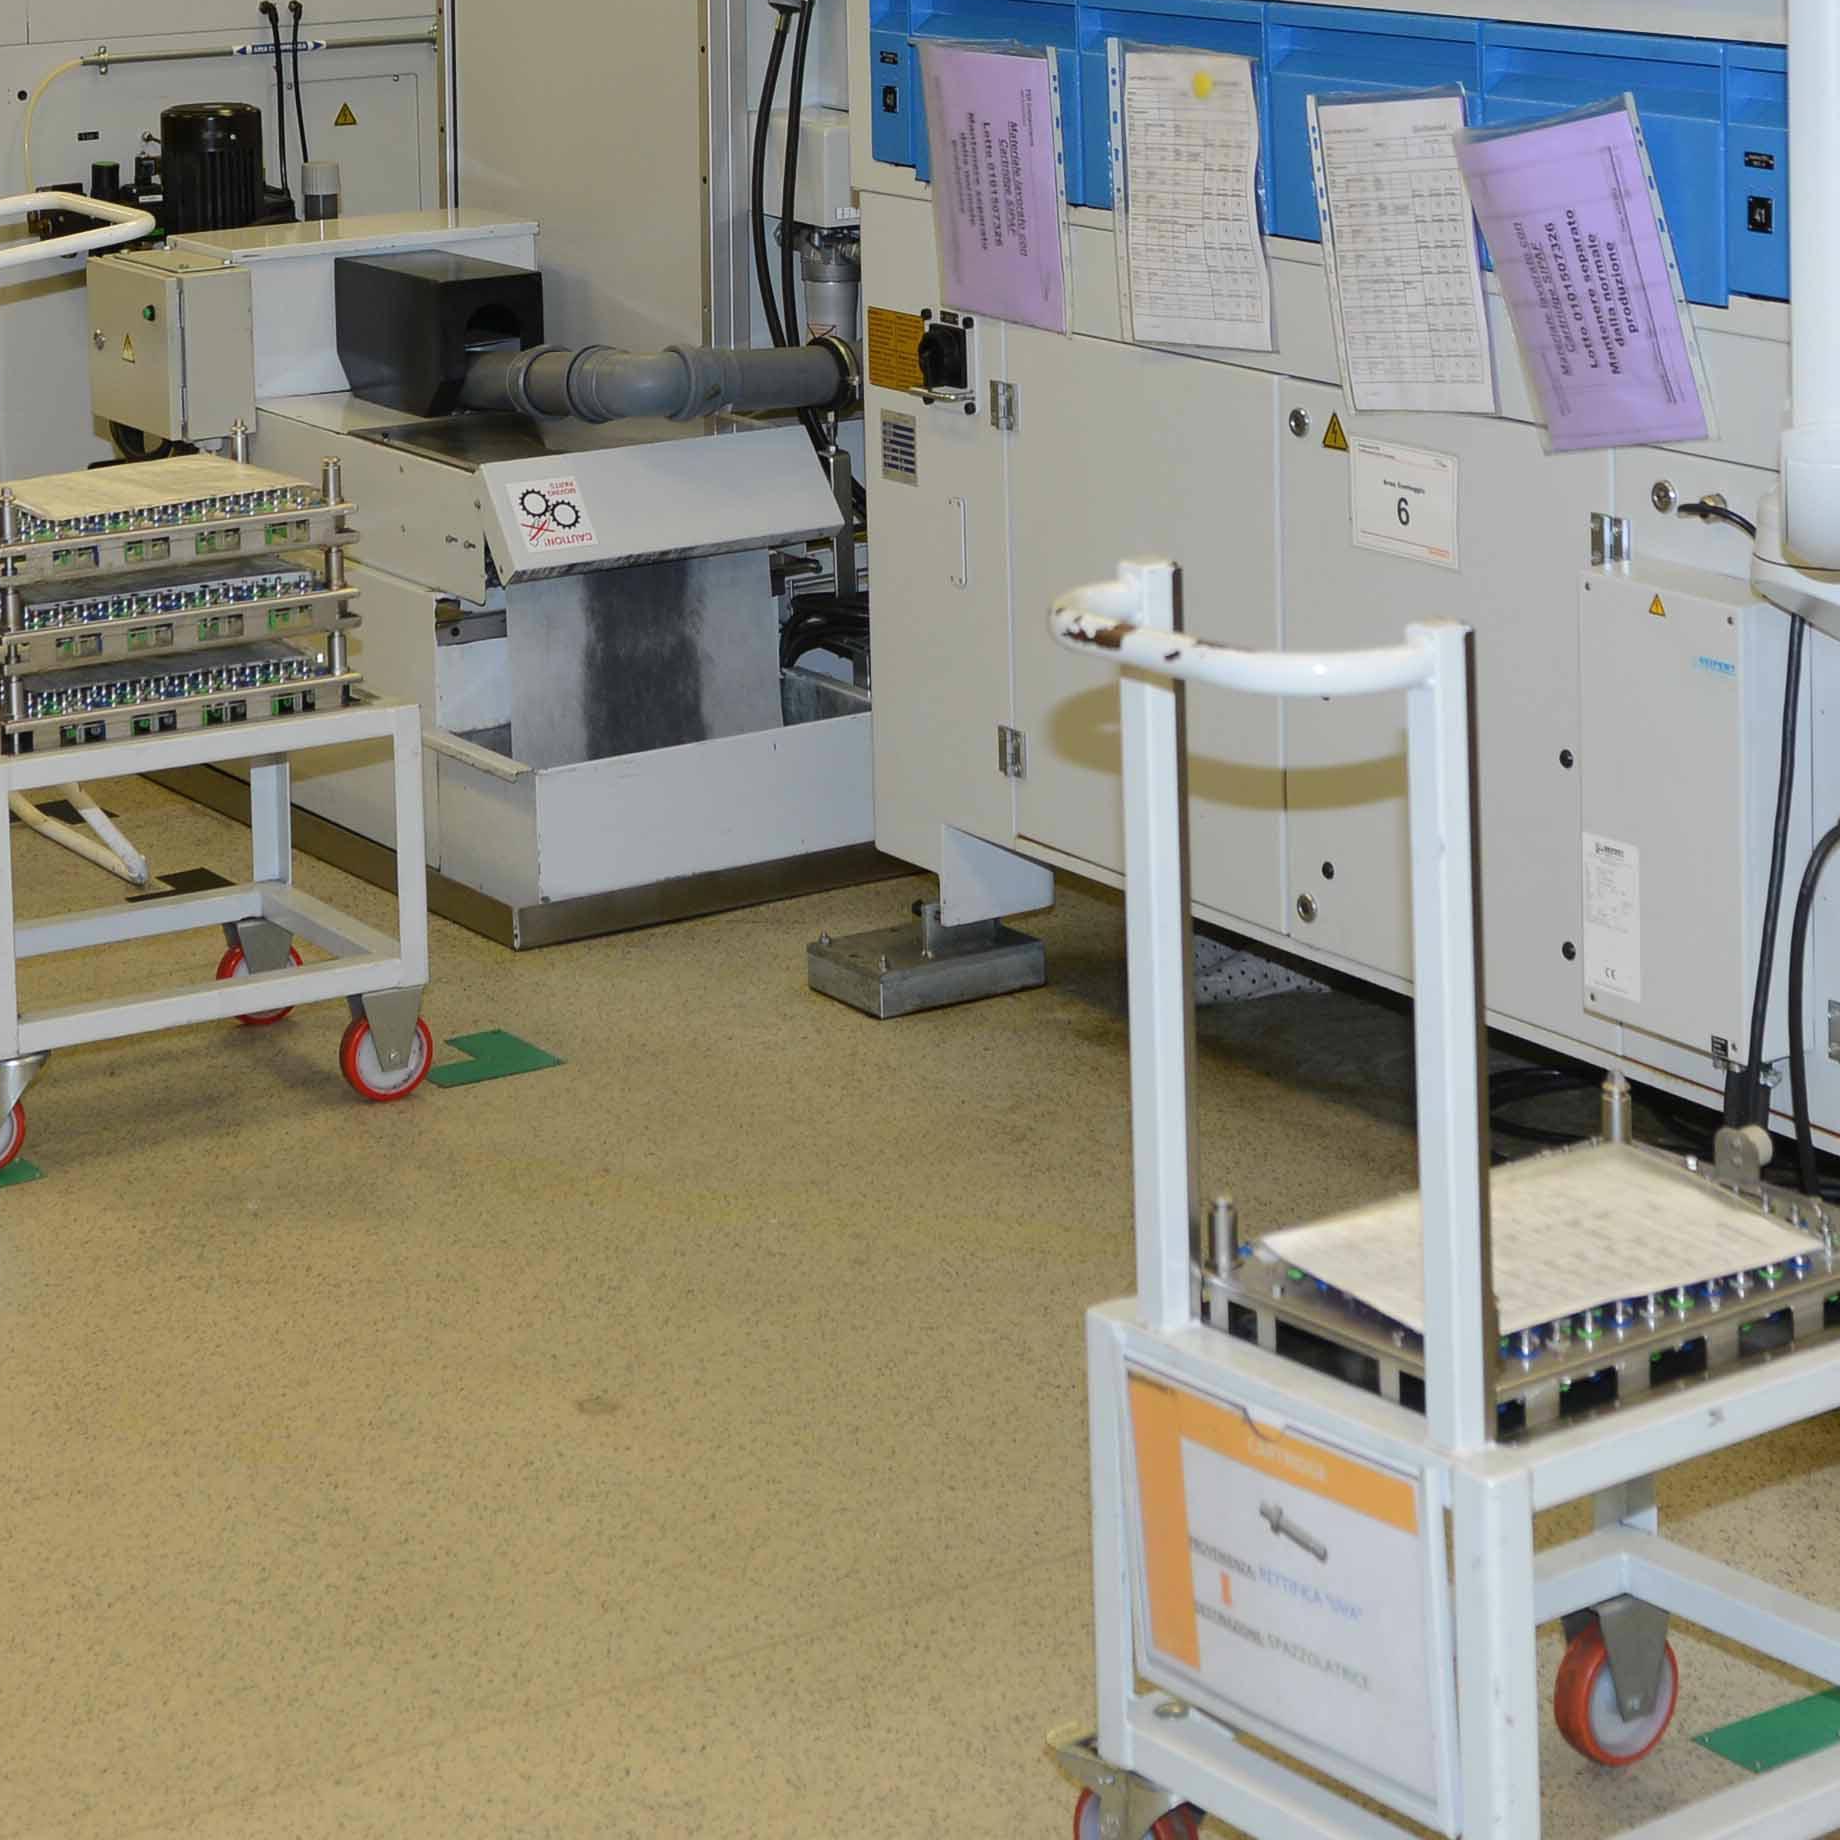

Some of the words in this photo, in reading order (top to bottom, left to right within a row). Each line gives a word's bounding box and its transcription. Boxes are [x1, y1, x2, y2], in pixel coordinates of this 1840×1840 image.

[1543, 221, 1584, 321] 0101507326
[1563, 208, 1594, 282] separato
[1585, 232, 1614, 302] normale
[1602, 241, 1639, 333] produzione
[1577, 325, 1598, 368] Lotto
[1585, 287, 1621, 374] Mantenere
[1604, 306, 1626, 347] dalla
[1397, 496, 1410, 526] 6
